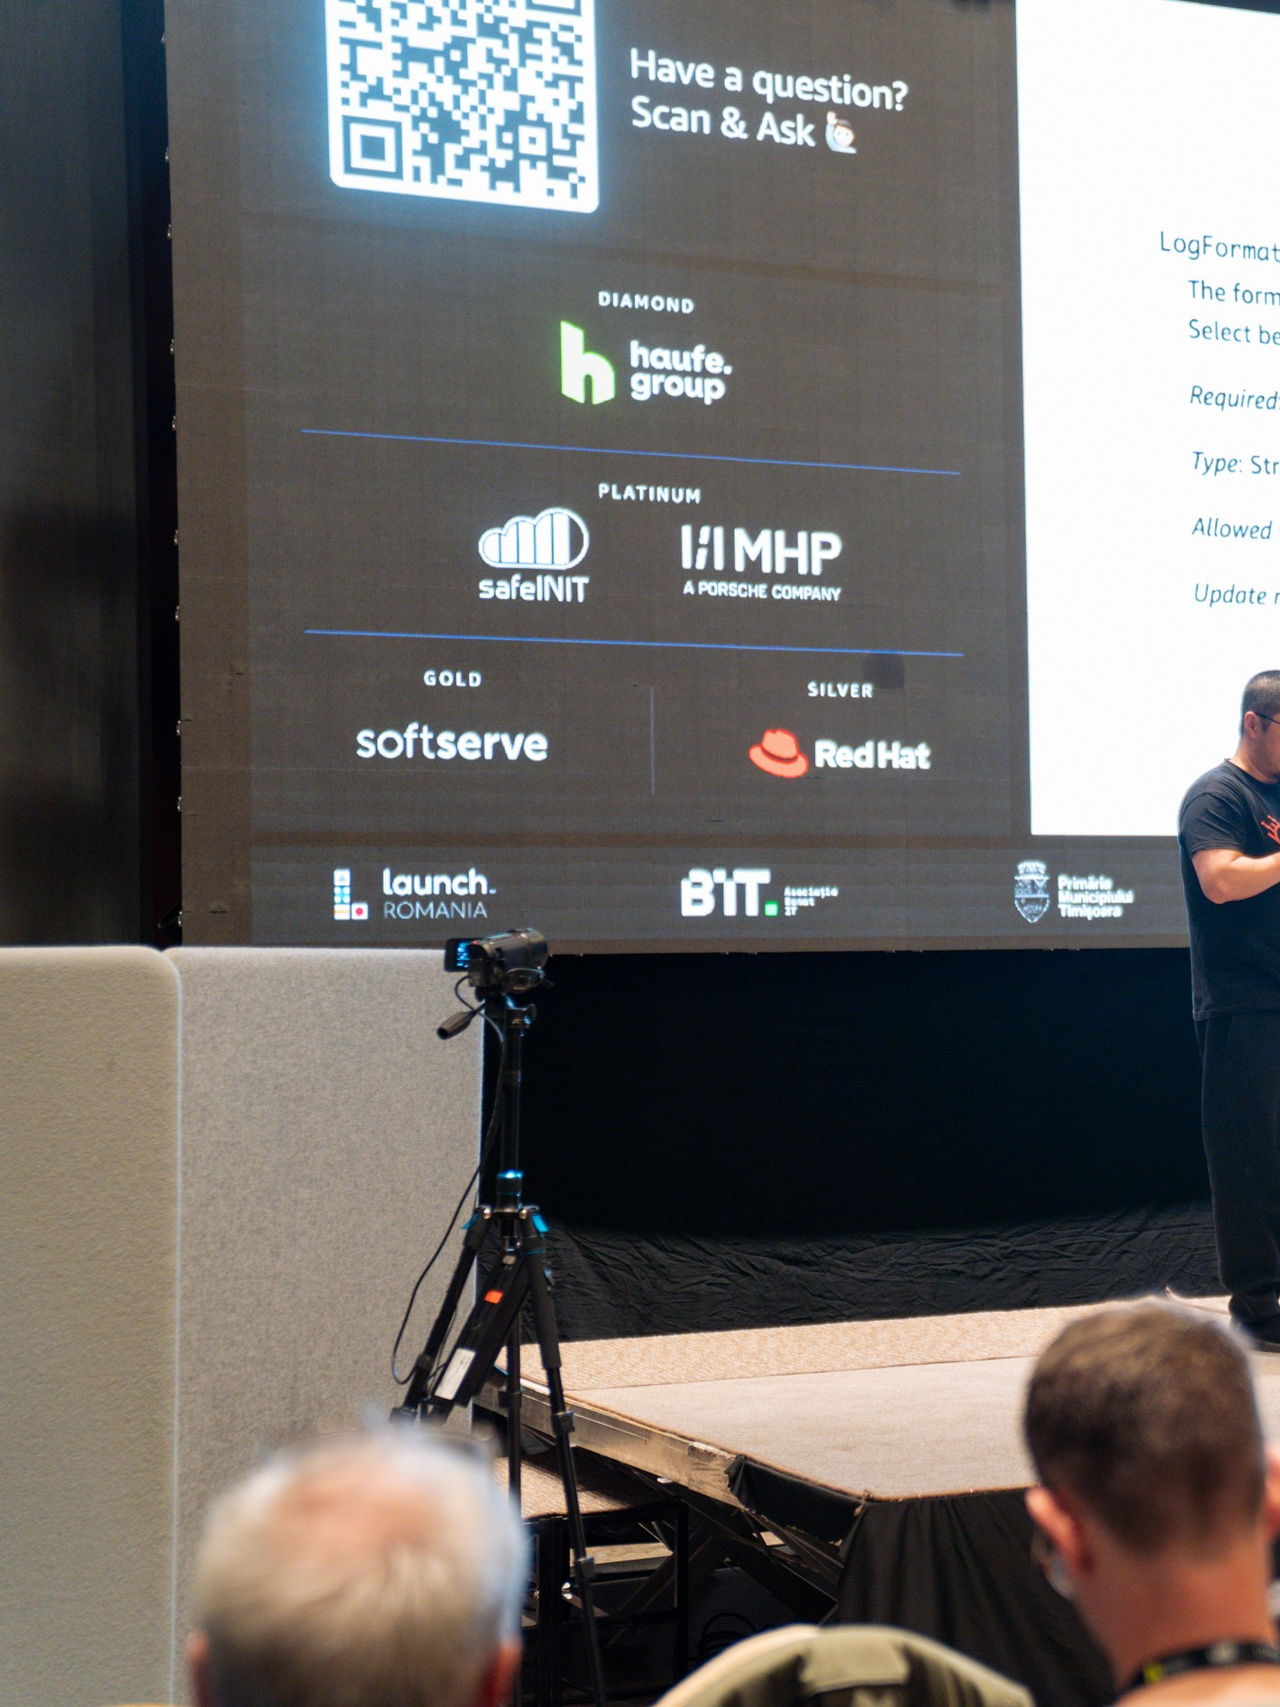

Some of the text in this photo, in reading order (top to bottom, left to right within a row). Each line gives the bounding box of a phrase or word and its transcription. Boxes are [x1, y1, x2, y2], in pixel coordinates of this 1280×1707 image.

[629, 46, 909, 111] Have a question?
[630, 94, 817, 148] Scan & Ask
[598, 290, 695, 315] DIAMOND
[1187, 279, 1226, 303] The
[1188, 318, 1251, 344] Select
[630, 371, 726, 406] group
[1192, 450, 1243, 477] Type:
[598, 482, 701, 504] PLATINUM
[1191, 516, 1273, 540] Allowed
[682, 579, 842, 602] A PORSCHE COMPANY
[1194, 583, 1268, 608] Update
[423, 669, 482, 688] GOLD
[807, 680, 873, 699] SILVER
[356, 721, 549, 762] softserve
[383, 900, 488, 920] ROMANIA
